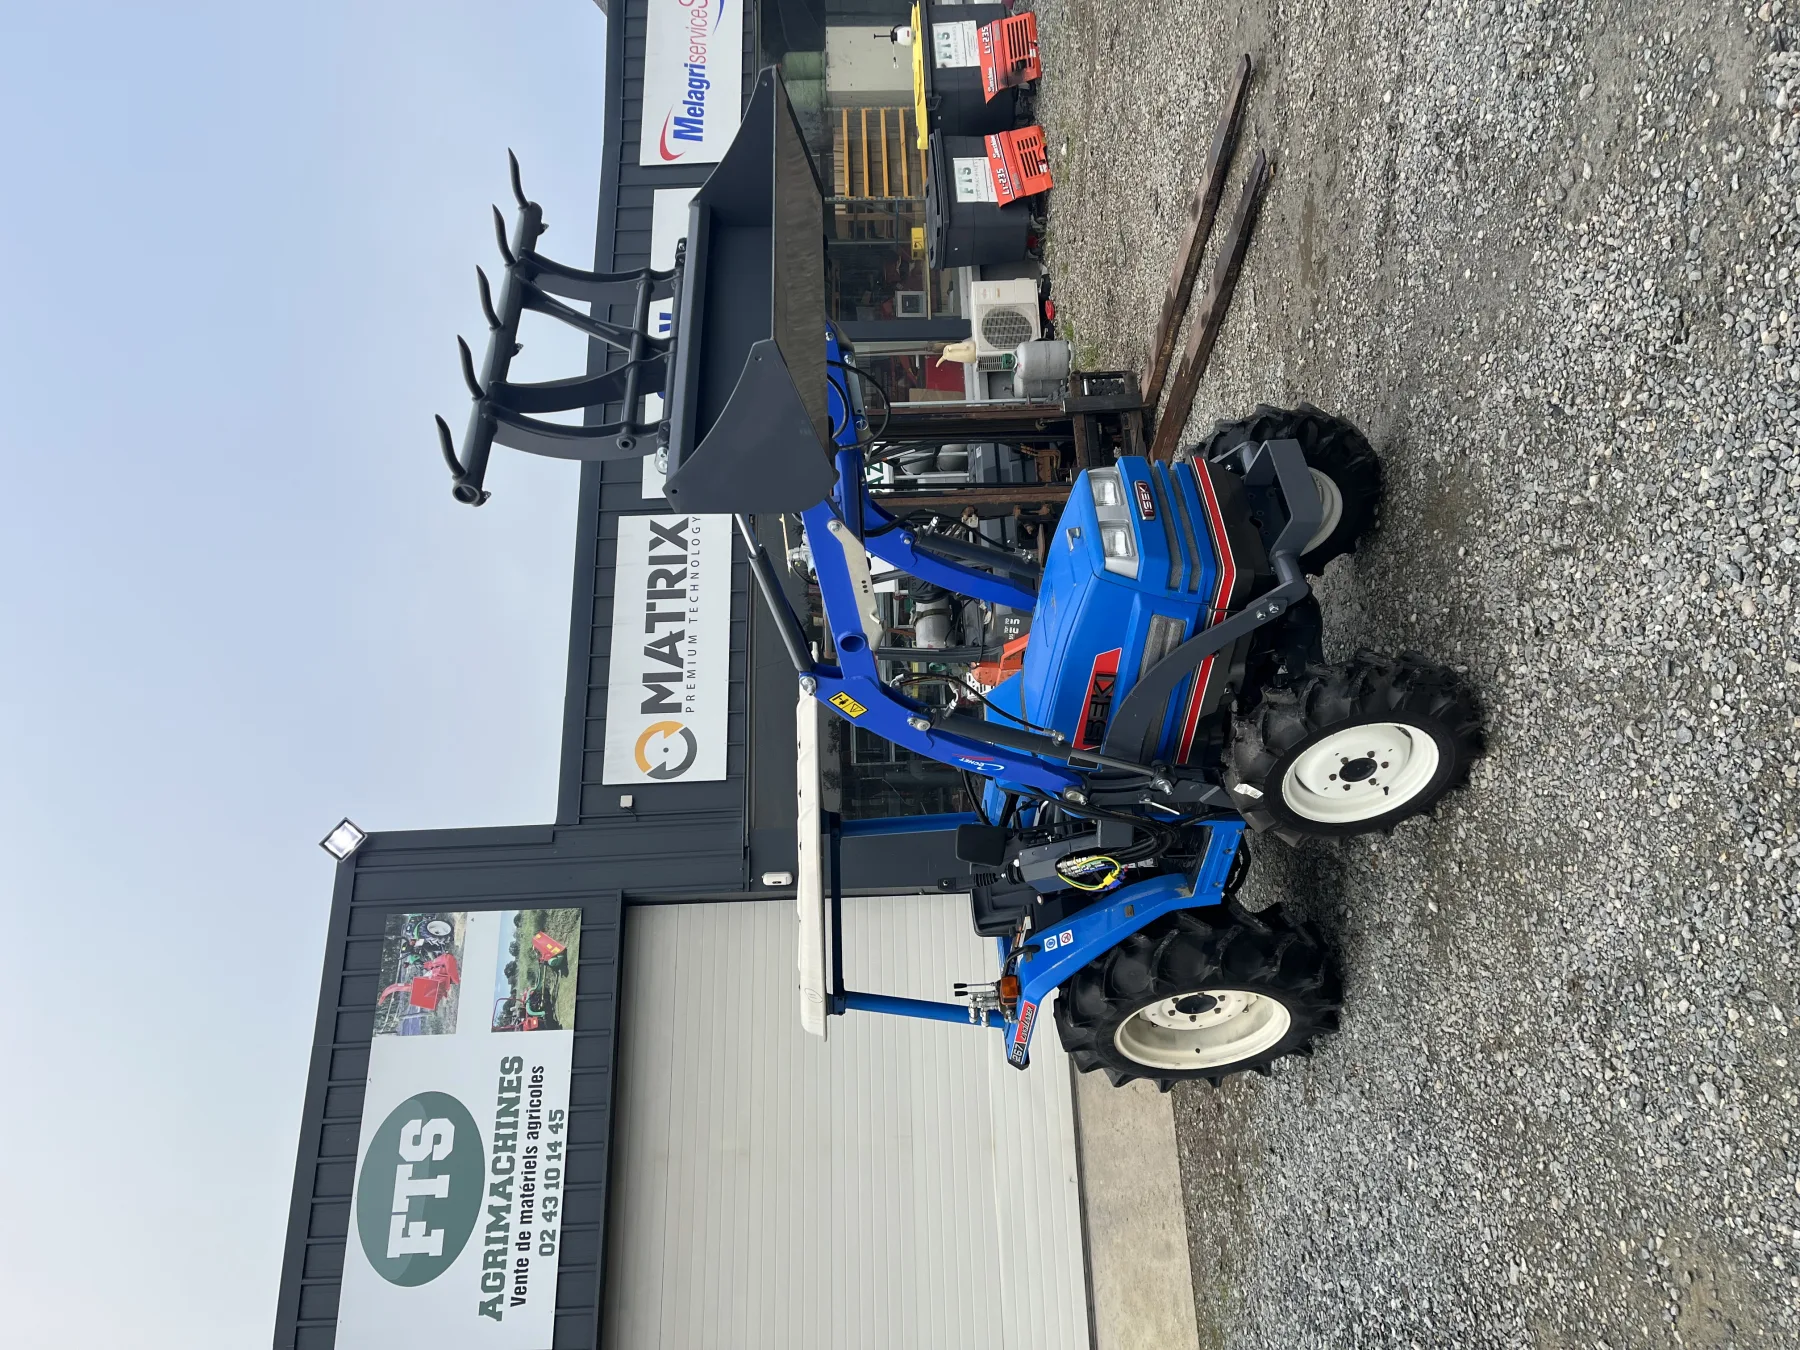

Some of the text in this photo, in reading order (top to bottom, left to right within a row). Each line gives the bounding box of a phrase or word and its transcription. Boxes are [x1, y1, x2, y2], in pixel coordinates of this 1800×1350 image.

[936, 32, 952, 60] FTS
[958, 167, 974, 194] FTS
[1138, 482, 1154, 513] ISEKI
[640, 516, 689, 714] MATRIX
[686, 516, 701, 713] PREMIUM TECHNOLOGY
[1082, 672, 1117, 746] ISEKI
[1012, 1044, 1024, 1062] 267
[386, 1118, 455, 1258] FTS
[478, 1056, 524, 1322] AGRIMACHINES
[510, 1066, 544, 1307] Vente de matériels agricoles
[538, 1109, 564, 1256] 02 43 10 14 45
